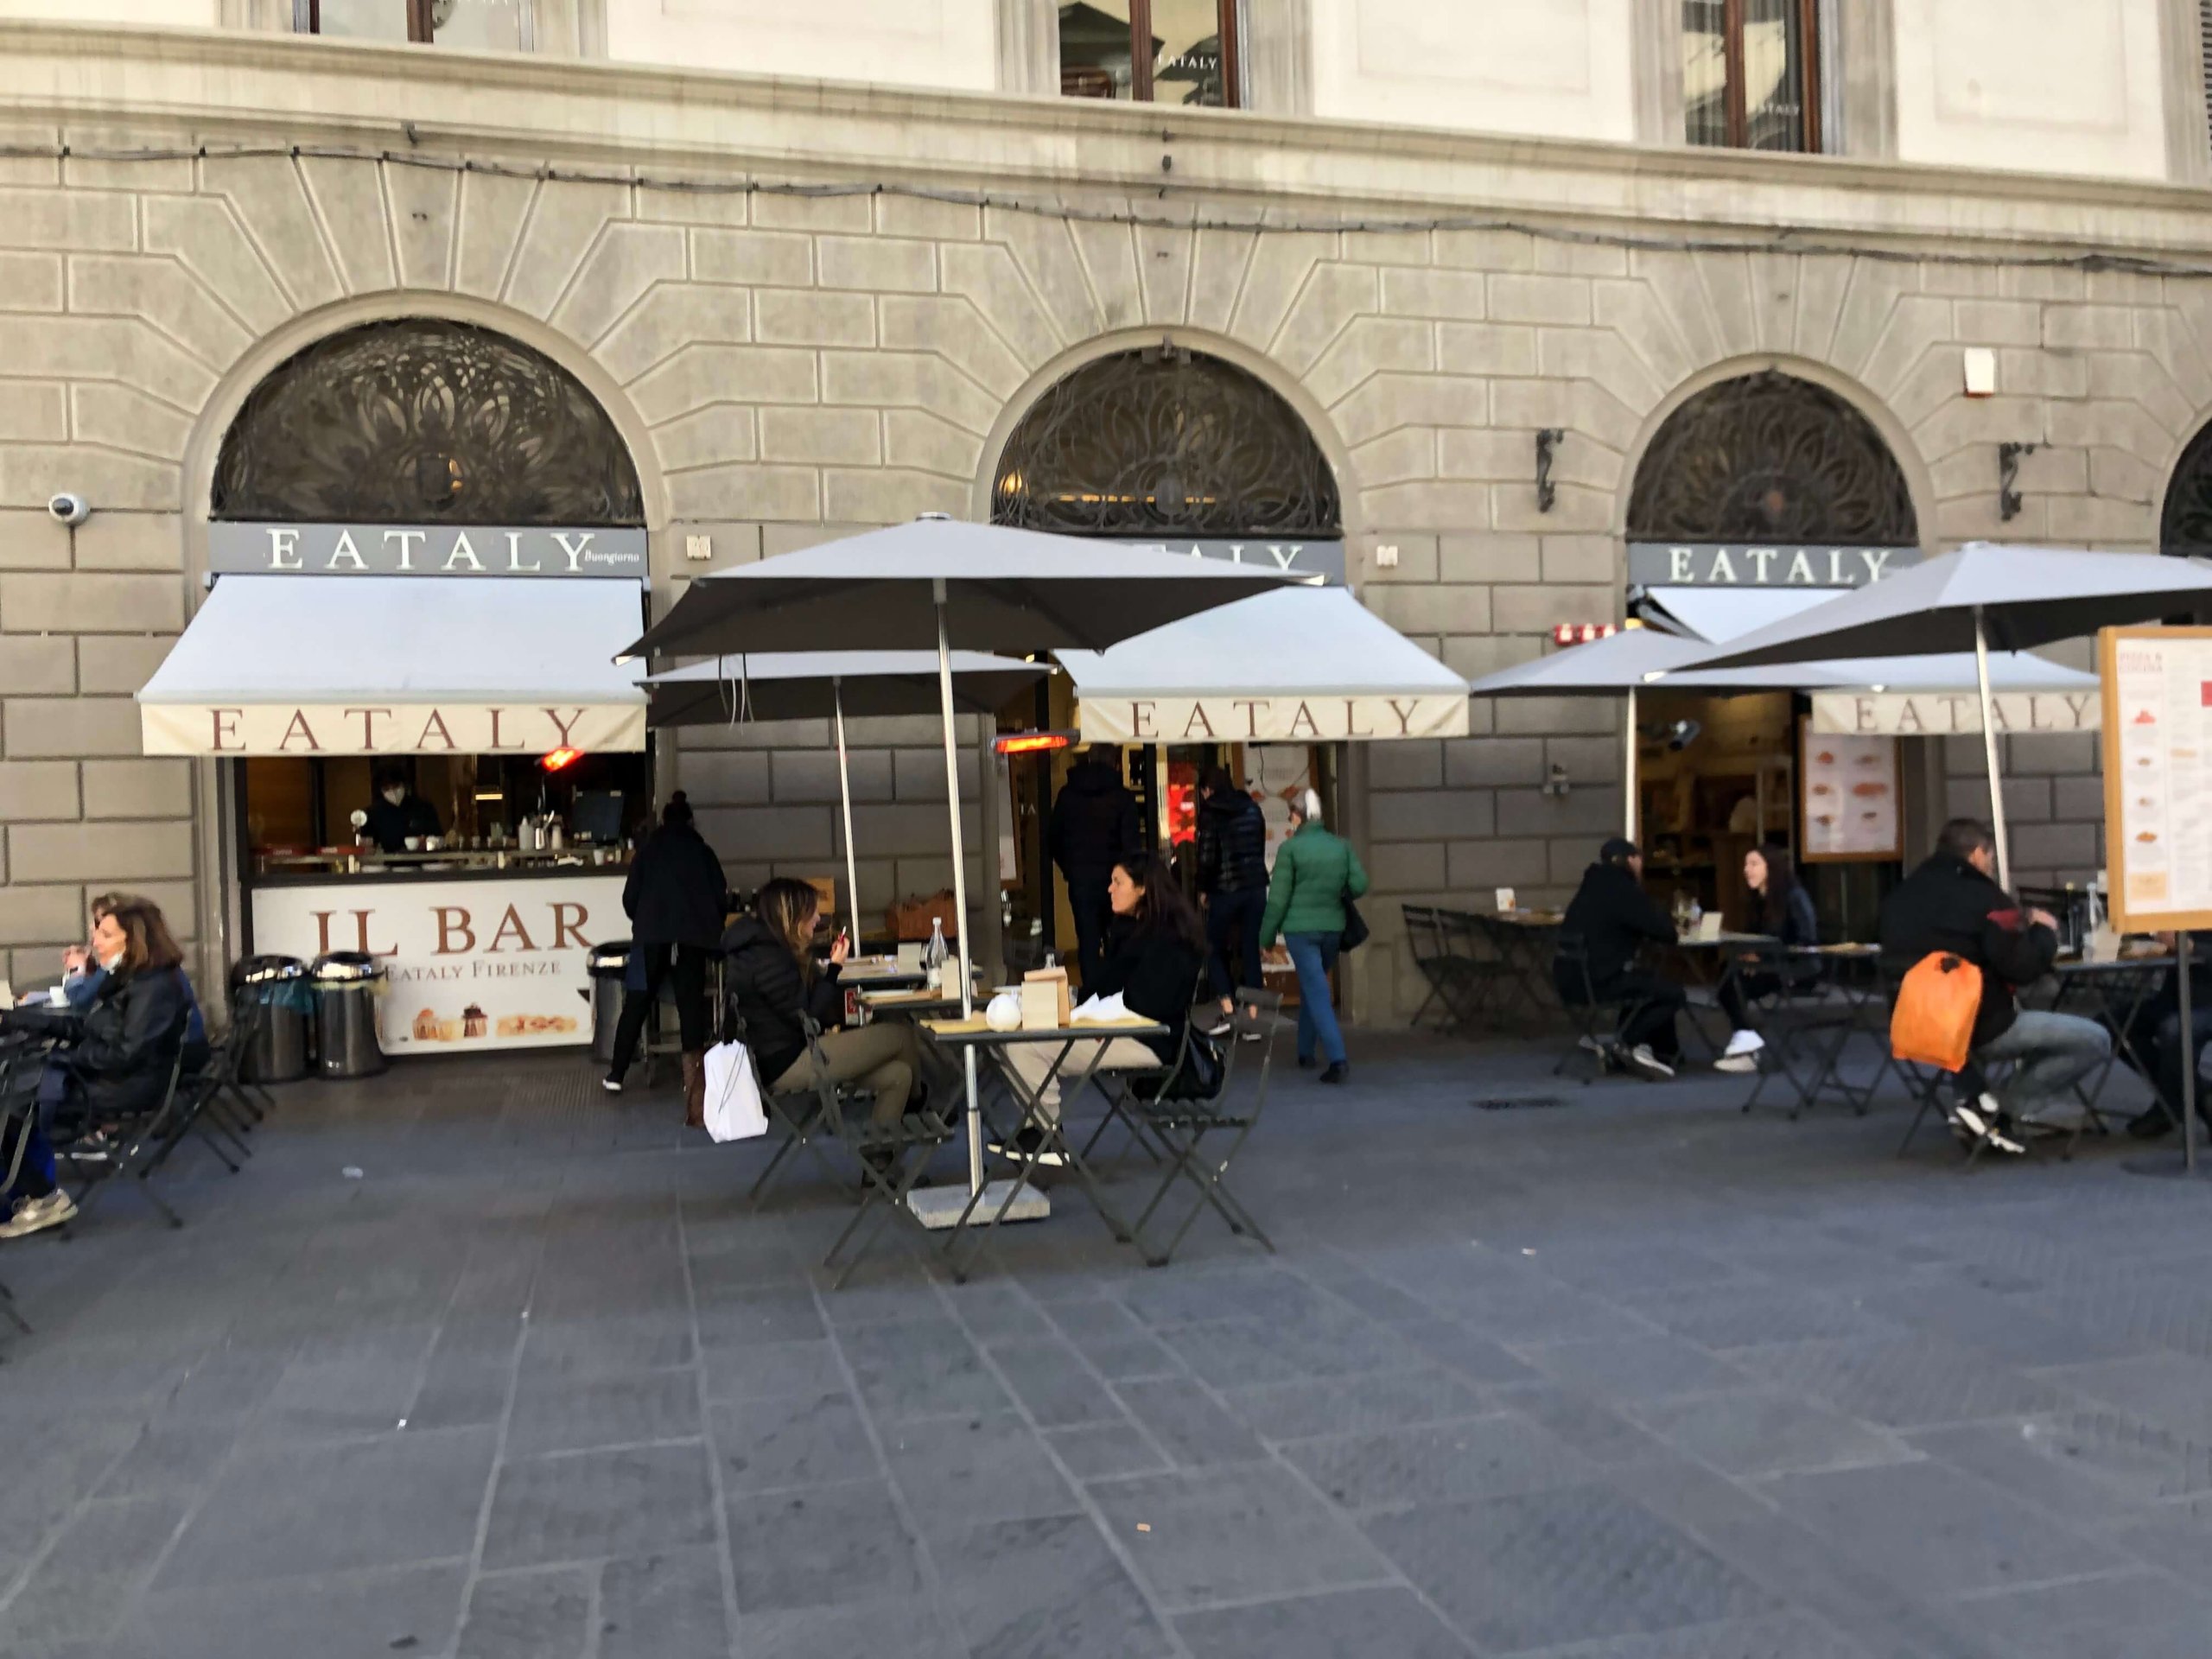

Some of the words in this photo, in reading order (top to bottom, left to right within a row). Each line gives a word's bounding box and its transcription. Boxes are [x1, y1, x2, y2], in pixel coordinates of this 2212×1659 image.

[266, 528, 594, 571] EATALY
[584, 549, 639, 566] Buongiorno
[1669, 547, 1892, 583] EATALY
[208, 708, 586, 750] EATALY
[1128, 699, 1421, 739] EATALY
[1854, 694, 2089, 732] EATALY
[308, 908, 398, 957] IL
[429, 902, 594, 956] BAR
[385, 963, 463, 982] EATALY
[473, 960, 562, 979] FIRENZE
